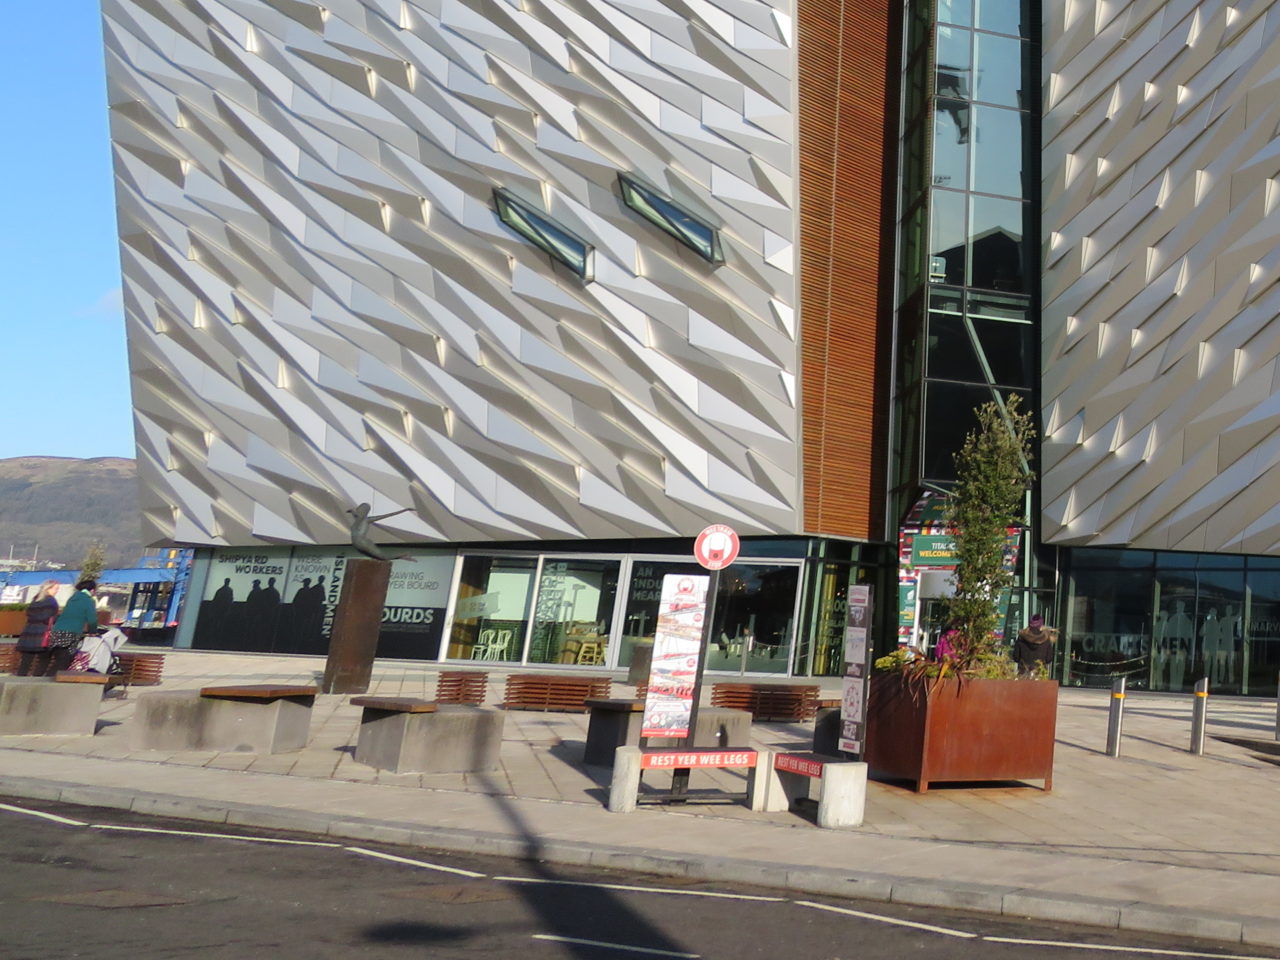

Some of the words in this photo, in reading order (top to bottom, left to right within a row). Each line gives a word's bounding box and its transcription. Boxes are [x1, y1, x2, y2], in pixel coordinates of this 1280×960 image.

[219, 553, 269, 565] SHIPYARD
[918, 550, 954, 558] WELCOME
[235, 565, 284, 575] WORKERS
[294, 564, 331, 574] KNOWN
[637, 567, 653, 577] AN
[292, 574, 305, 583] AS
[390, 571, 425, 581] RAWING
[381, 607, 434, 624] OURDS
[650, 755, 675, 766] REST
[677, 754, 697, 766] YER
[699, 754, 721, 765] WEE
[724, 753, 748, 765] LEGS
[777, 755, 790, 767] REST
[789, 757, 799, 769] YER
[799, 760, 808, 772] WEE
[808, 762, 821, 776] LEGS
